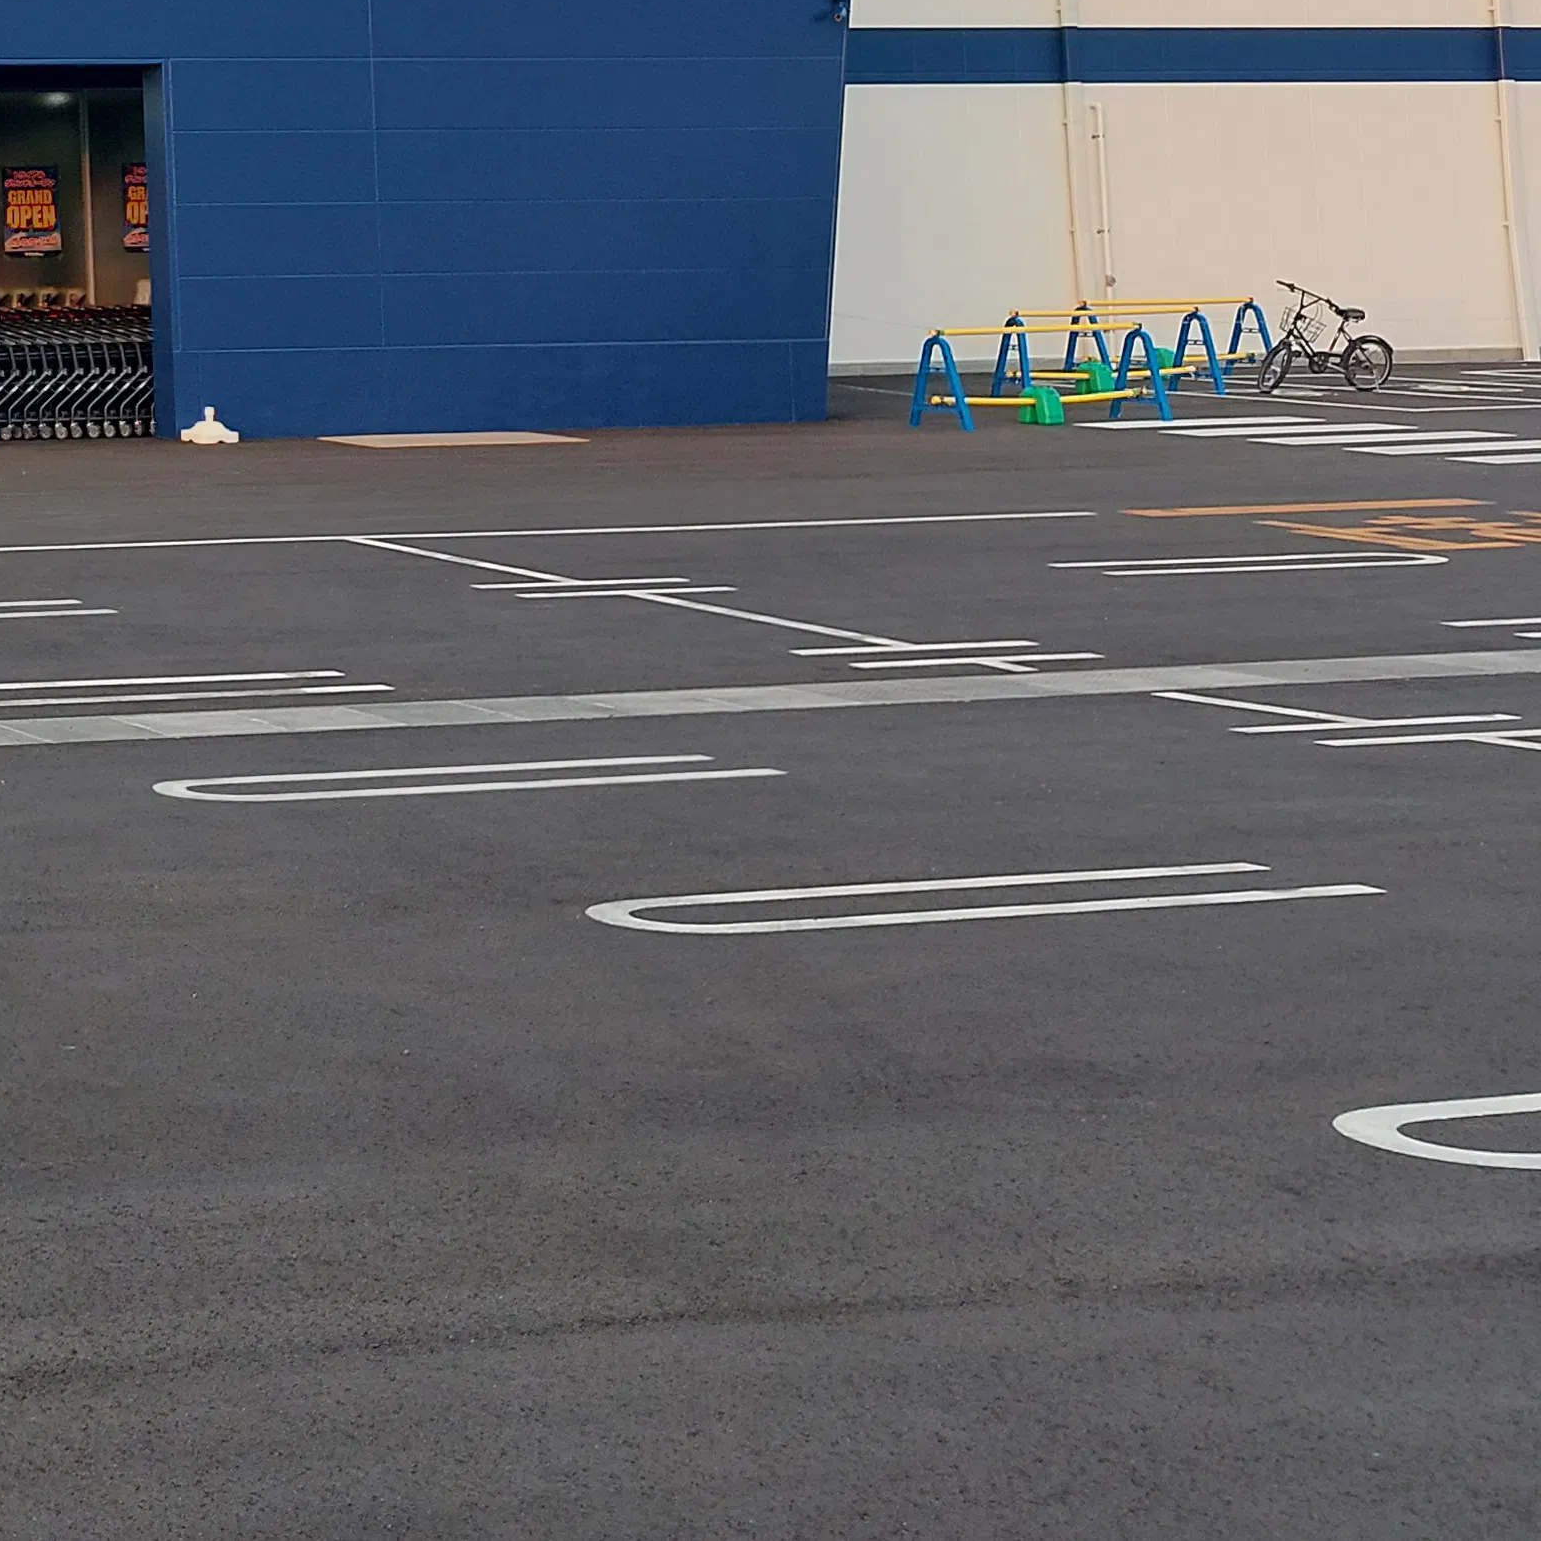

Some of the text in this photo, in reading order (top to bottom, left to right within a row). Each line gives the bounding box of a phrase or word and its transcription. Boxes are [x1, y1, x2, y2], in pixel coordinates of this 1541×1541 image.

[8, 190, 52, 204] GRAND
[7, 205, 57, 228] OPEN
[126, 200, 149, 224] OP
